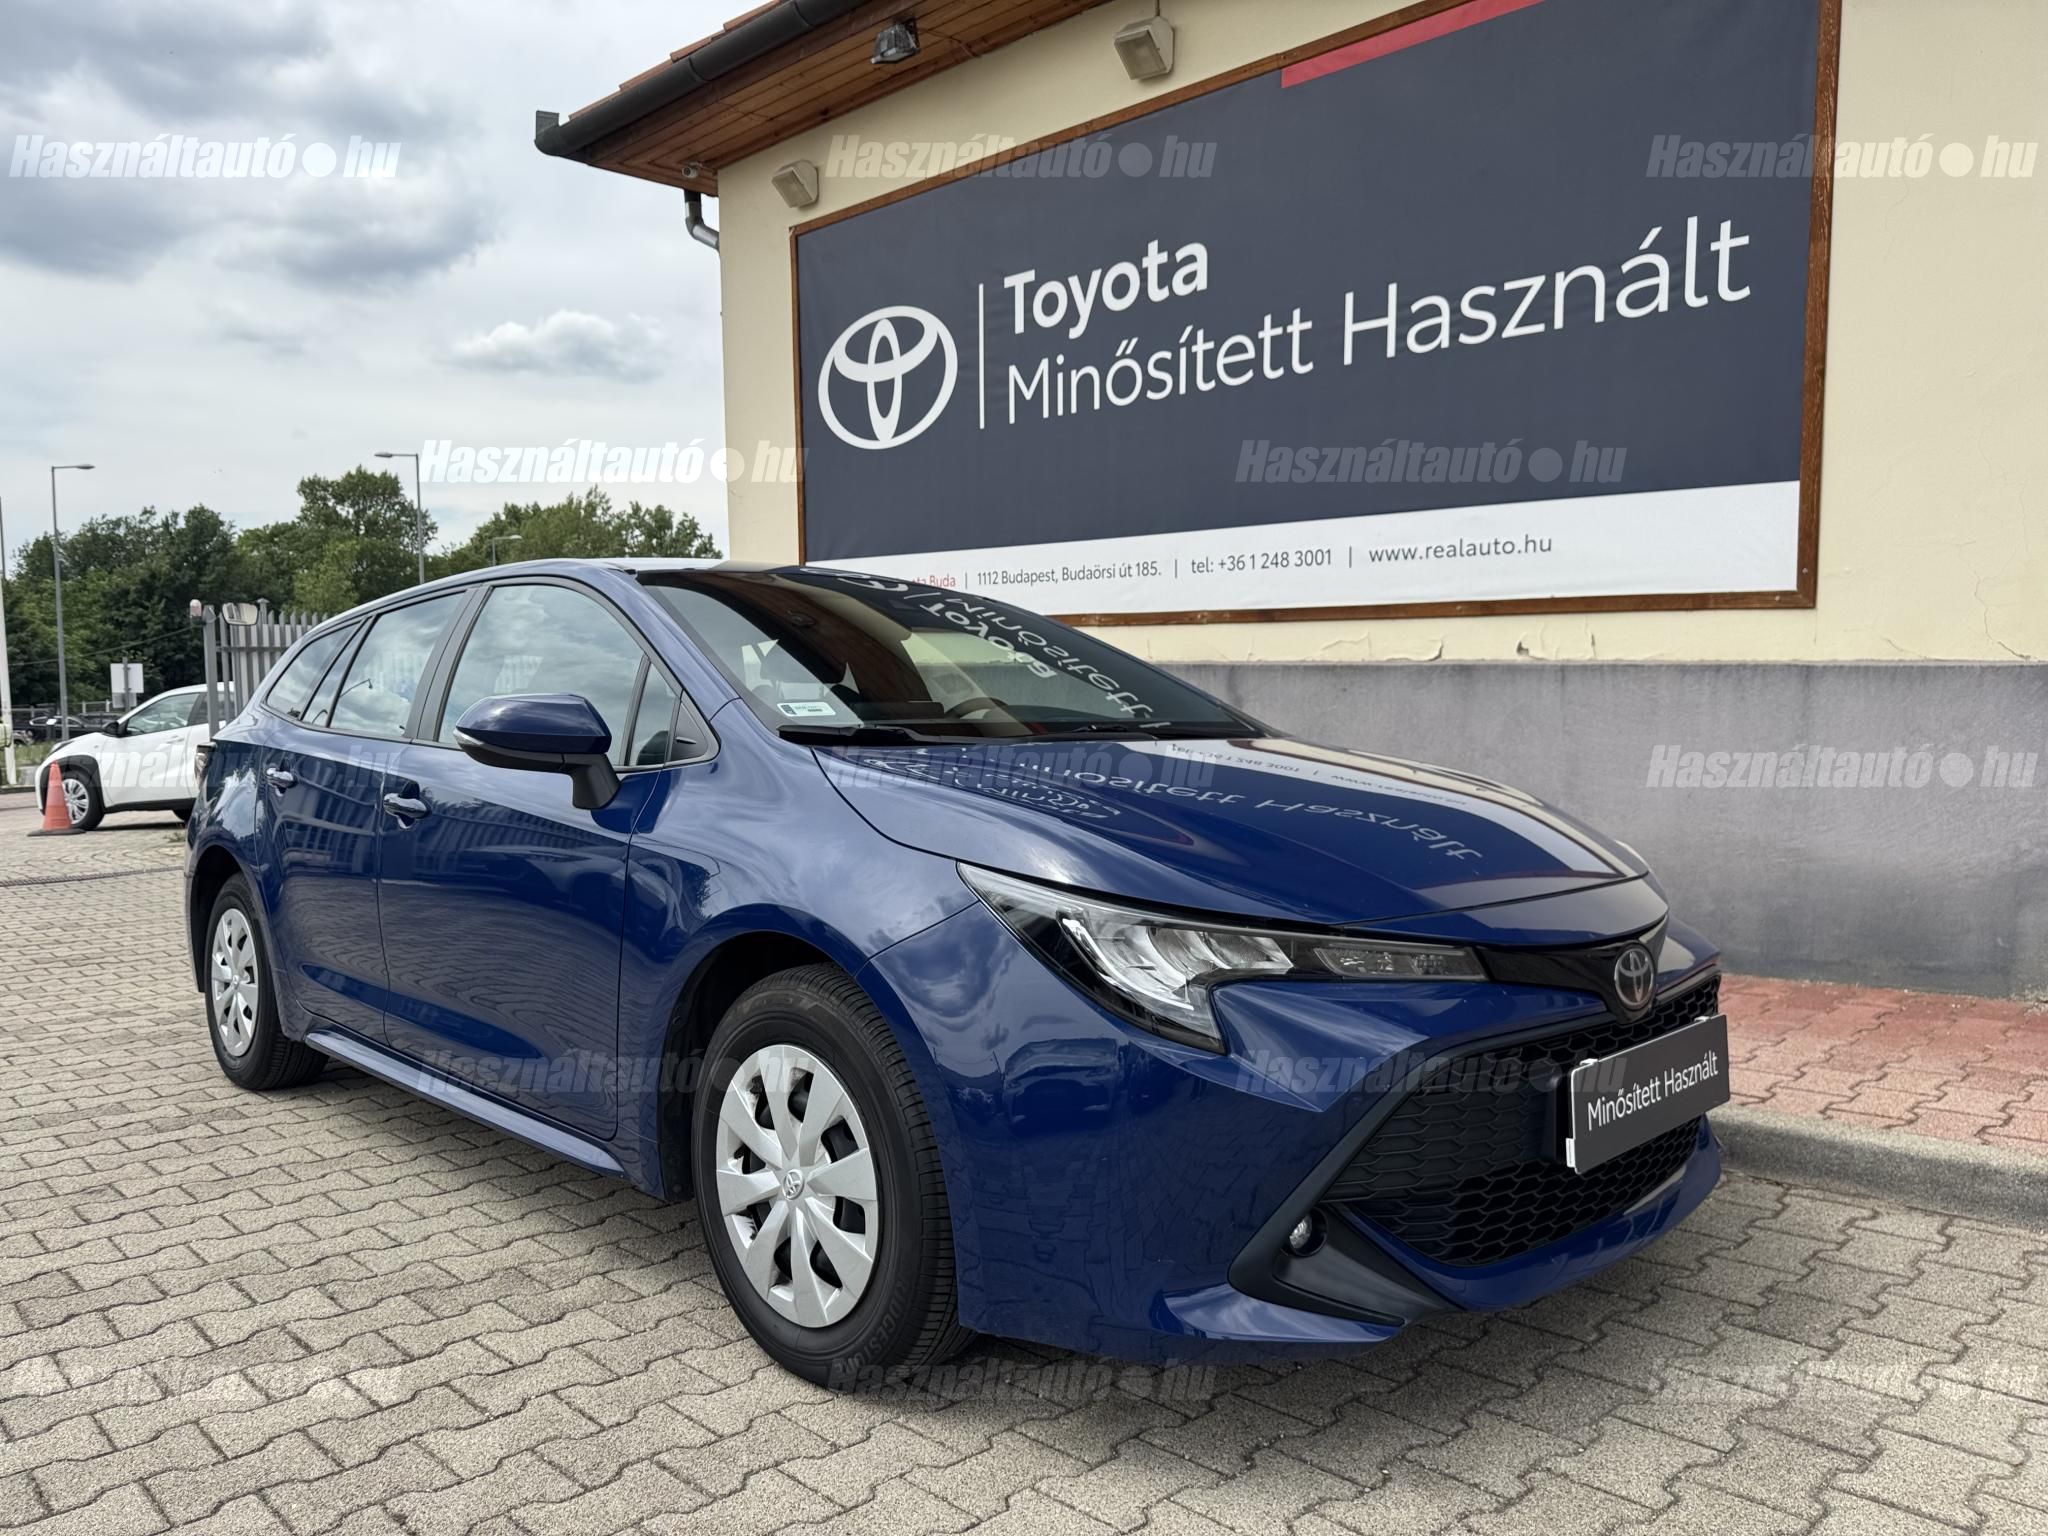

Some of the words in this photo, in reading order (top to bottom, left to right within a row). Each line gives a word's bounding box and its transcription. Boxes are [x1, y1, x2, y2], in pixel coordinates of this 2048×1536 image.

[1004, 239, 1208, 339] Toyota
[1008, 305, 1314, 425] Minősített
[1342, 214, 1751, 365] Használt
[977, 570, 999, 586] 1112
[1001, 568, 1059, 587] Budapest,
[1062, 563, 1116, 582] Budaörsi
[1119, 563, 1132, 579] út
[1136, 560, 1162, 577] 185.
[1191, 556, 1214, 574] tel:
[1218, 554, 1246, 572] +36
[1249, 553, 1256, 570] 1
[1260, 550, 1290, 570] 248
[1294, 548, 1332, 568] 3001
[1368, 533, 1553, 564] www.realauto.hu
[1587, 1075, 1661, 1131] Minősített
[1664, 1049, 1719, 1097] Használt
[834, 1274, 909, 1373] RIDGESTONE
